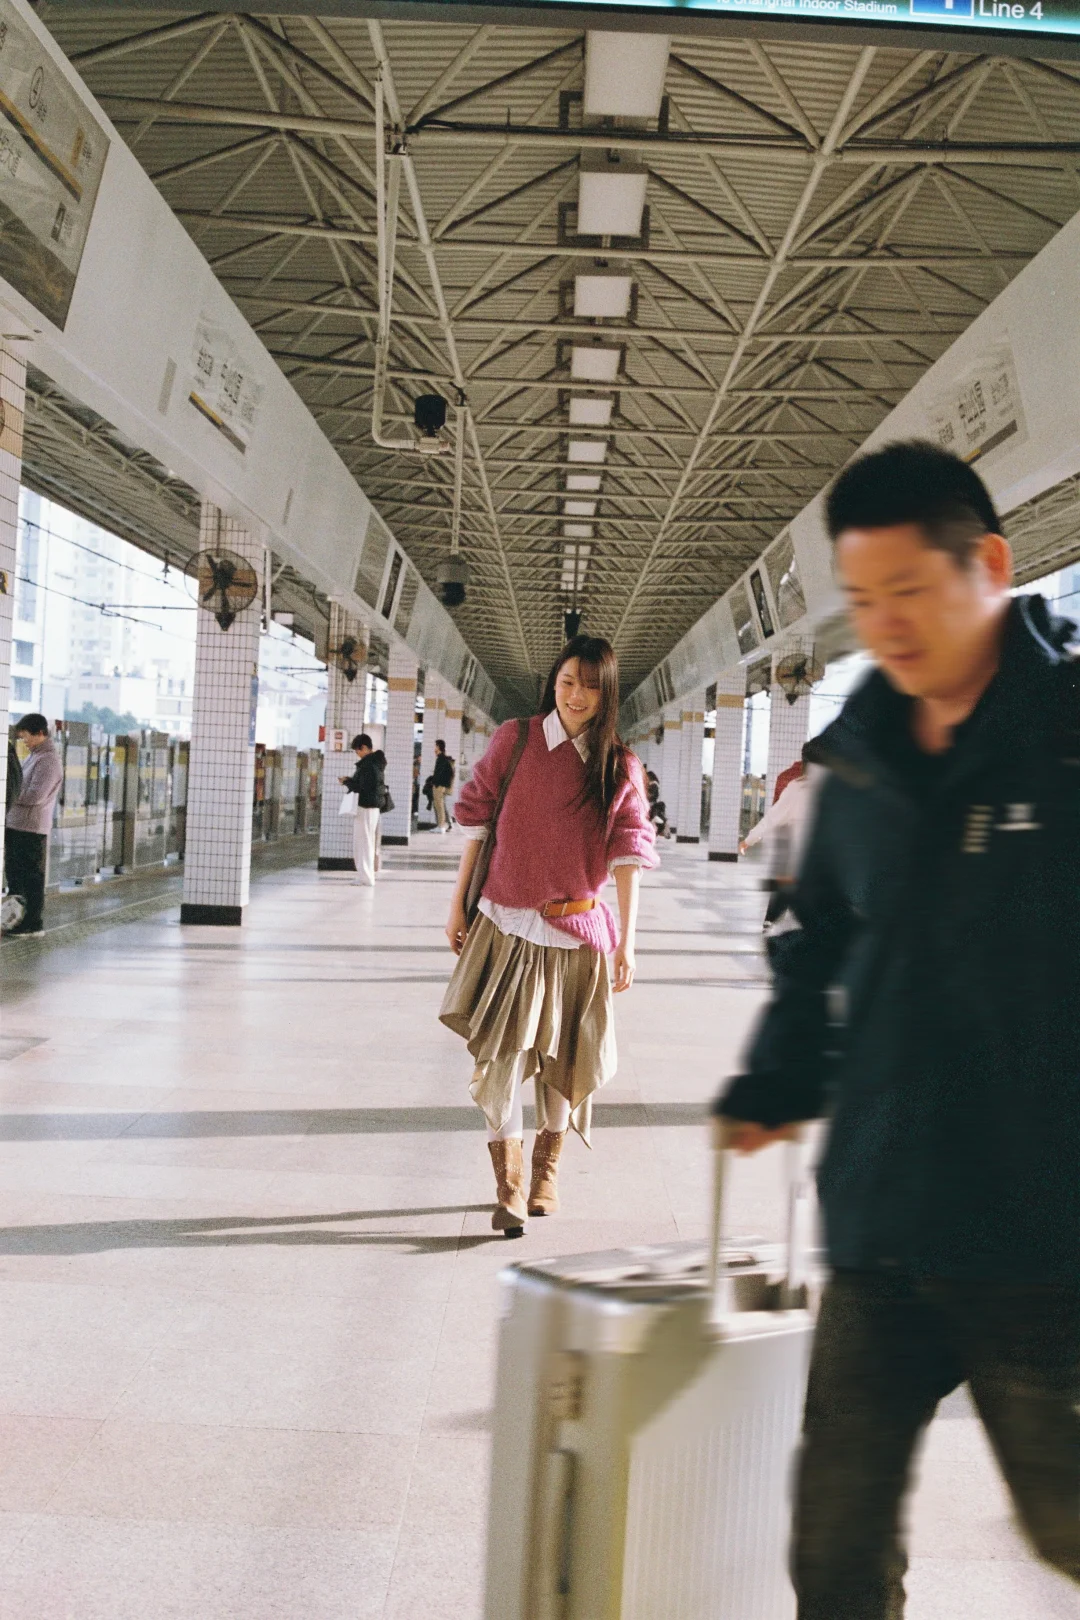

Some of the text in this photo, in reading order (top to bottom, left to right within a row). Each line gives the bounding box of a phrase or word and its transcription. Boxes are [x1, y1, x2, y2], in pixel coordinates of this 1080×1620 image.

[800, 0, 841, 10] Indoor
[844, 0, 897, 14] Stadium
[979, 0, 1044, 20] Line 4
